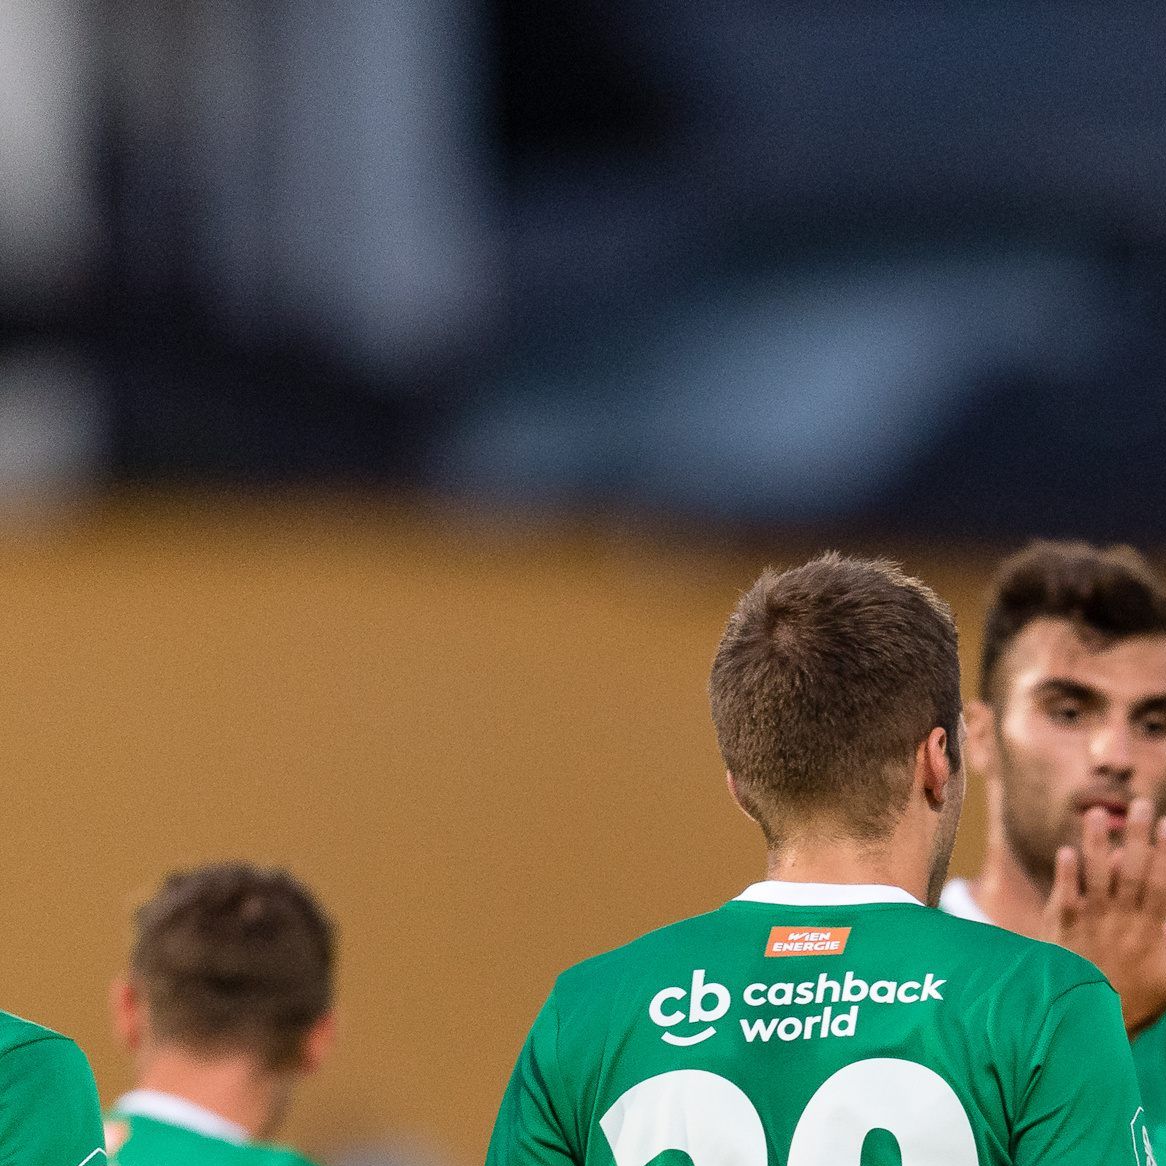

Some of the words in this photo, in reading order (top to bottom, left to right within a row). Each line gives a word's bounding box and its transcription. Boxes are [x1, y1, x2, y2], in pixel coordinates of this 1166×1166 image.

[772, 941, 841, 952] ENERGIE
[787, 932, 831, 942] WIEN
[649, 969, 731, 1027] cb
[743, 971, 947, 1006] cashback
[739, 1005, 860, 1043] world
